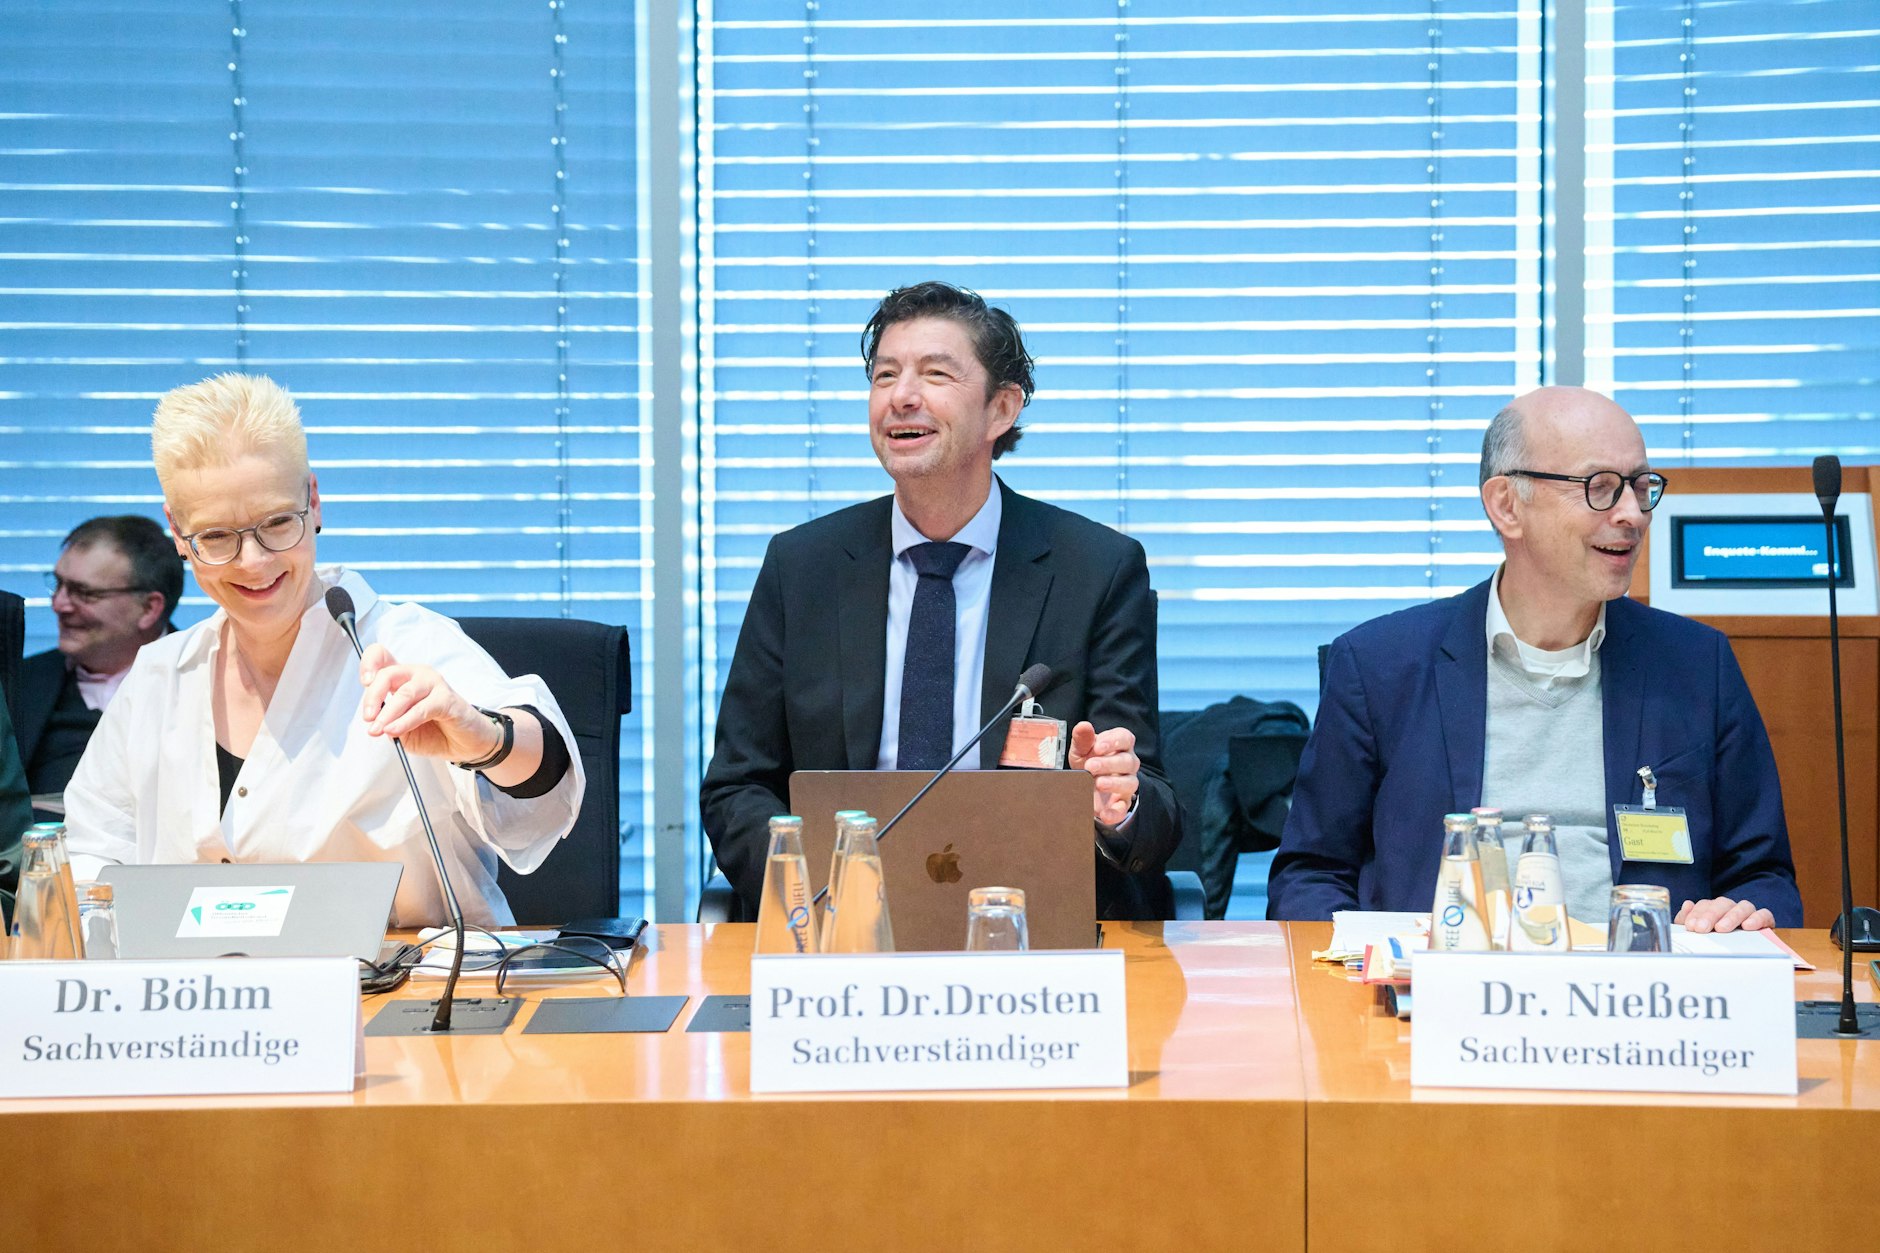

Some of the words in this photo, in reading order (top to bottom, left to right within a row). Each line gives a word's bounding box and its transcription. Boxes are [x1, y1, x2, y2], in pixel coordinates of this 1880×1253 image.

[1624, 836, 1643, 846] Gast
[53, 979, 122, 1013] Dr.
[140, 975, 272, 1011] Böhm
[768, 984, 864, 1018] Prof.
[1480, 981, 1548, 1016] Dr.
[1566, 982, 1731, 1020] Nießen
[22, 1031, 299, 1066] Sachverständige
[792, 1034, 1080, 1069] Sachverständiger
[1460, 1037, 1754, 1076] Sachverständiger
